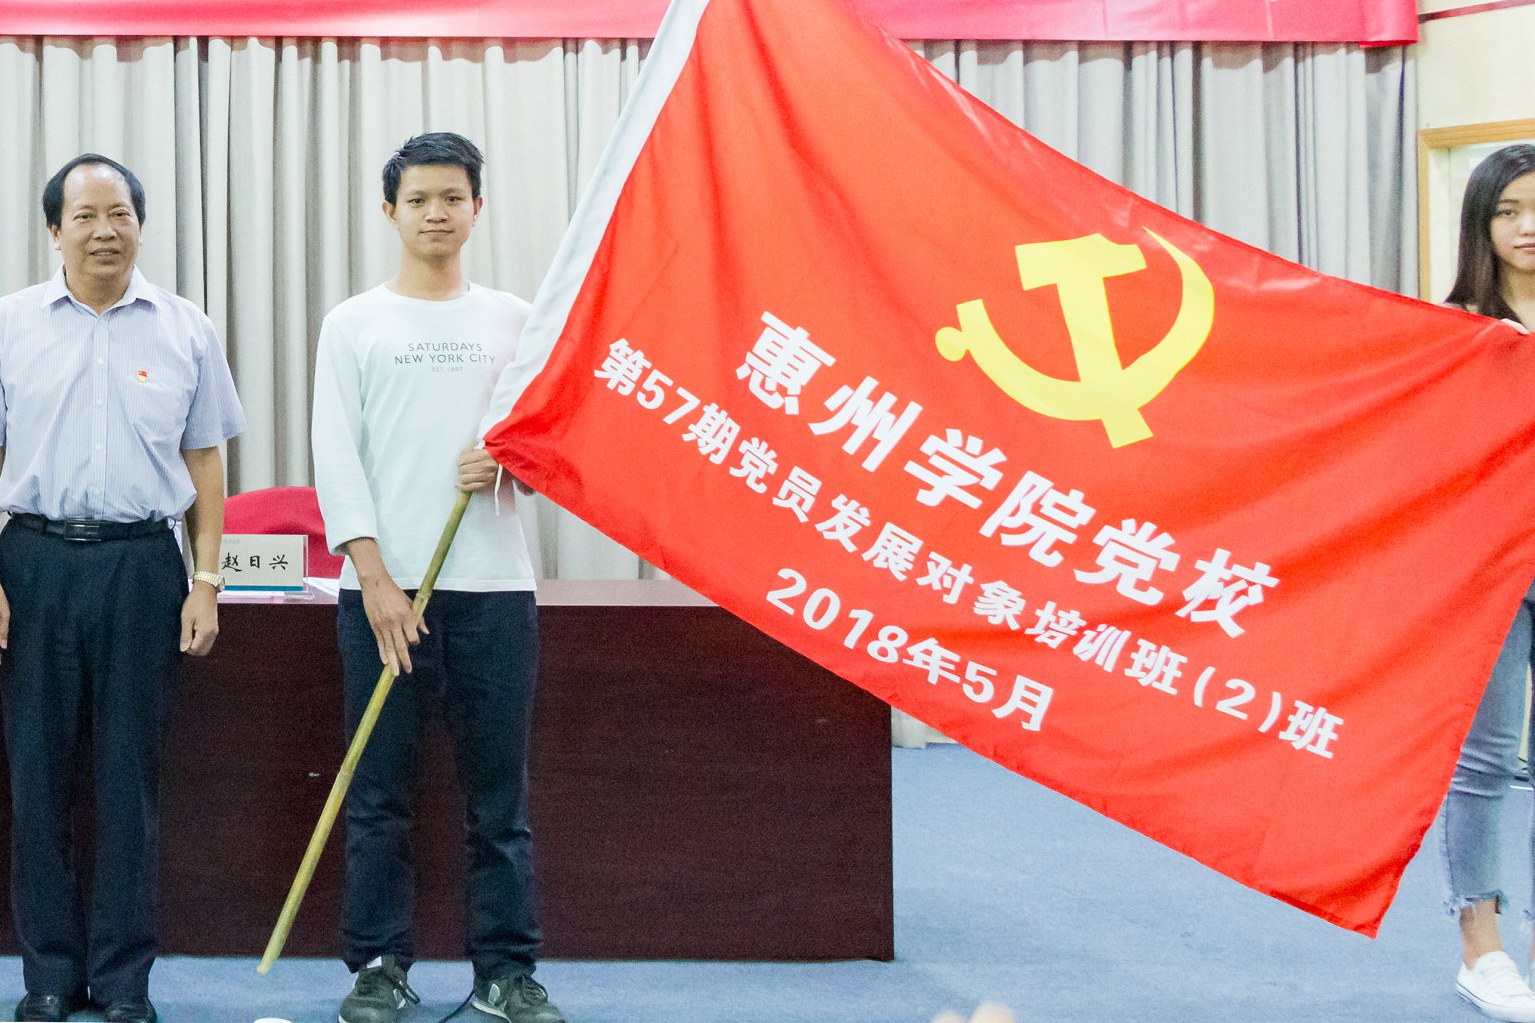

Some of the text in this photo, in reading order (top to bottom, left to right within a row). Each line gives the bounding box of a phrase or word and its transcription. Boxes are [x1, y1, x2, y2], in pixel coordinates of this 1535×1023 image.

[394, 353, 496, 365] NEW YORK CITY
[408, 342, 483, 352] SATURDAYS
[735, 311, 1280, 639] 惠州学院党校
[221, 552, 289, 573] 赵日兴
[594, 338, 1344, 759] 第57期党员发展对象培训班(2)班
[765, 568, 1054, 732] 2018年5月
